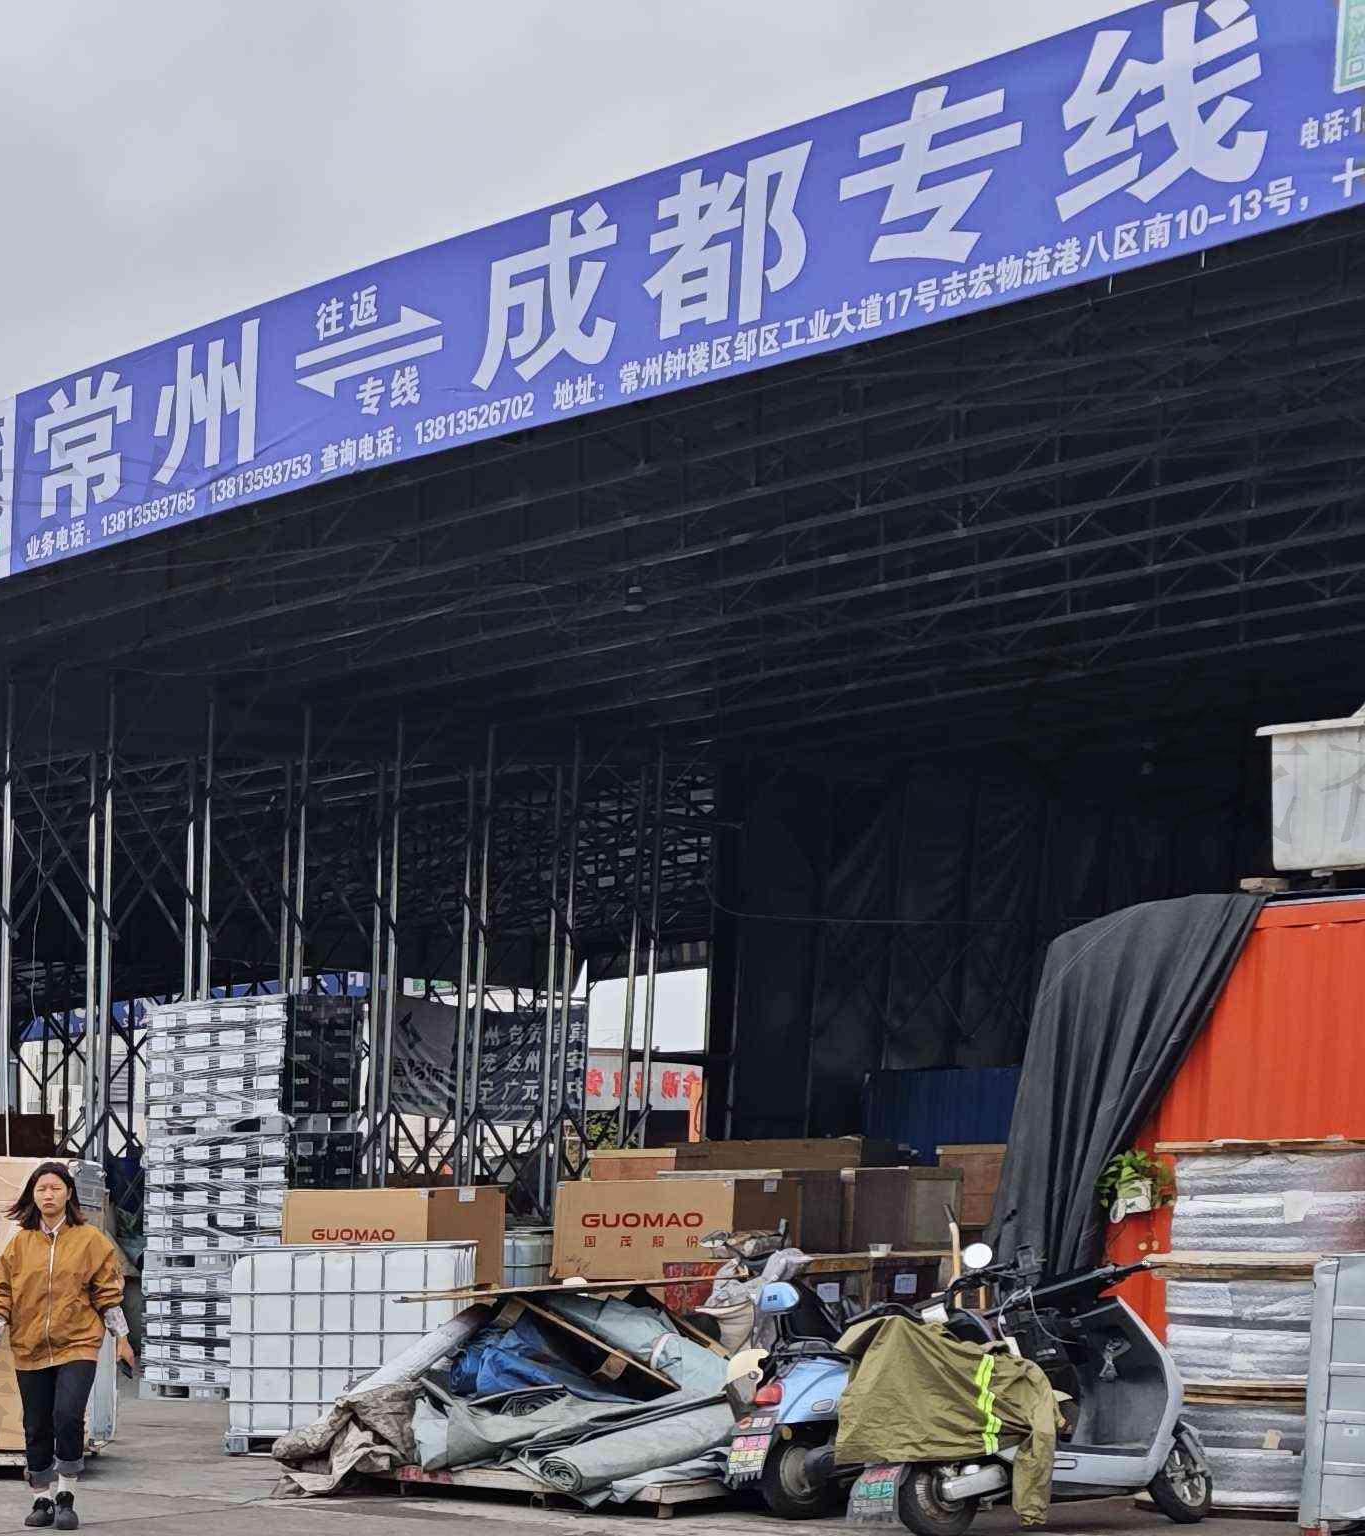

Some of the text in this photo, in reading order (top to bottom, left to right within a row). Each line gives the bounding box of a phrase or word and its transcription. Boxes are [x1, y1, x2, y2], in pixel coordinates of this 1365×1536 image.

[33, 0, 1268, 520] 常州 成都专线
[315, 284, 380, 342] 往返
[355, 364, 422, 417] 专线
[100, 488, 197, 537] 13813593765
[208, 453, 313, 505] 13813593753
[413, 392, 535, 446] 13813526702
[310, 1227, 396, 1243] GUOMAO
[581, 1211, 705, 1229] GUOMAO
